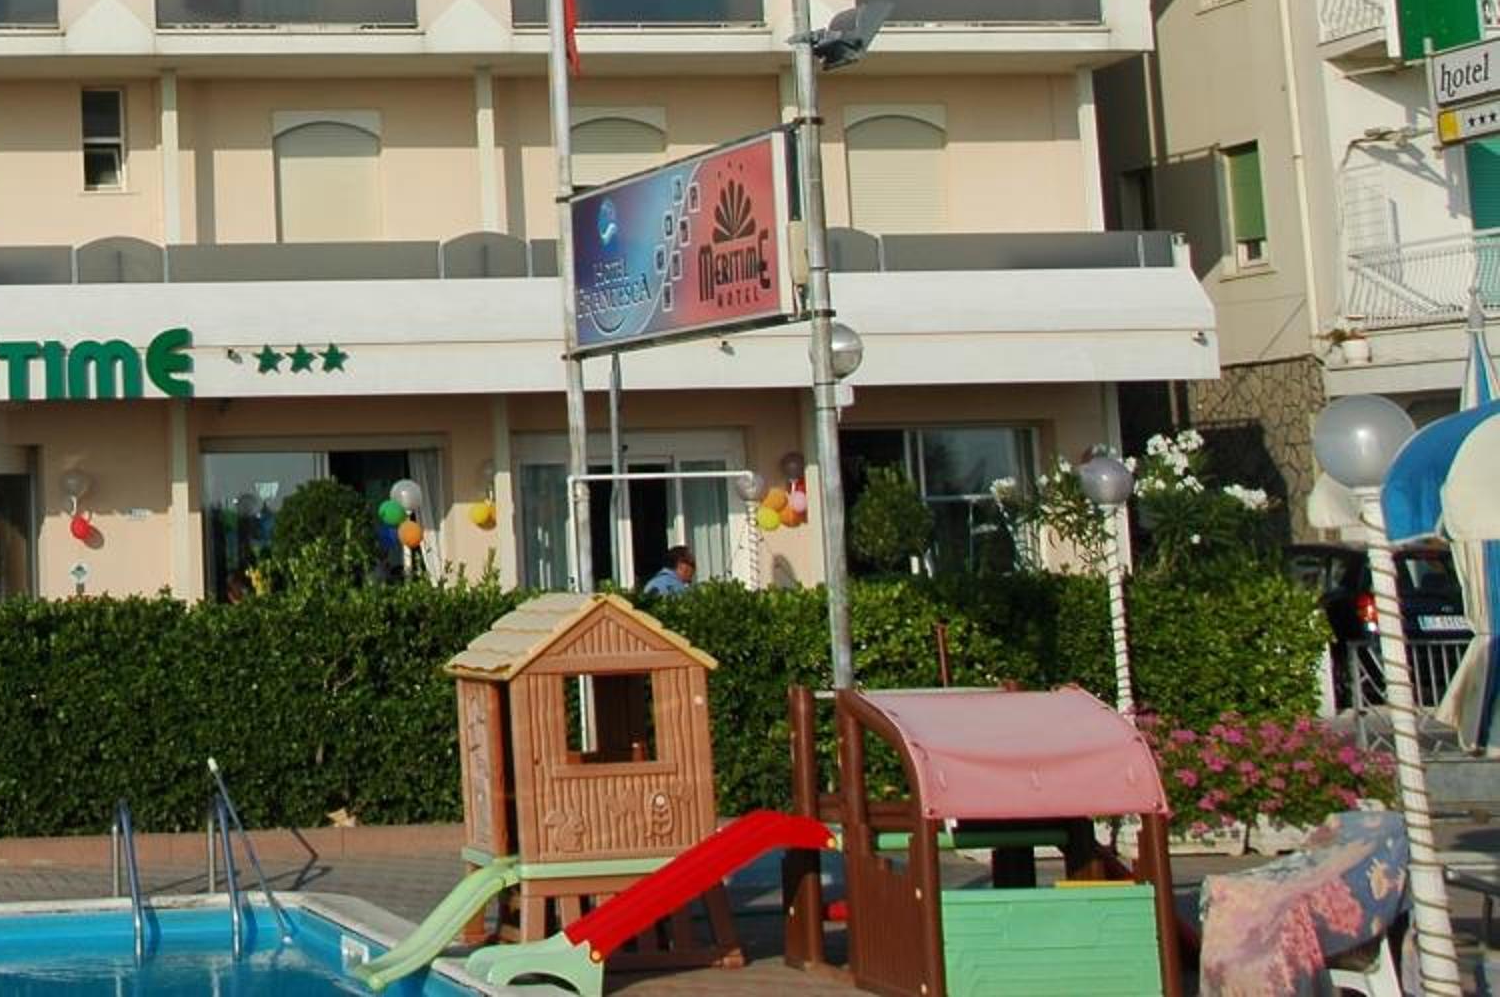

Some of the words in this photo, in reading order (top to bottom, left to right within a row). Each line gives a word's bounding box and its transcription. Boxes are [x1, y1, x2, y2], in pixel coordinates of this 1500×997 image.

[1440, 53, 1489, 97] hotel
[698, 229, 771, 302] MERITIME
[717, 285, 760, 308] HOTEL
